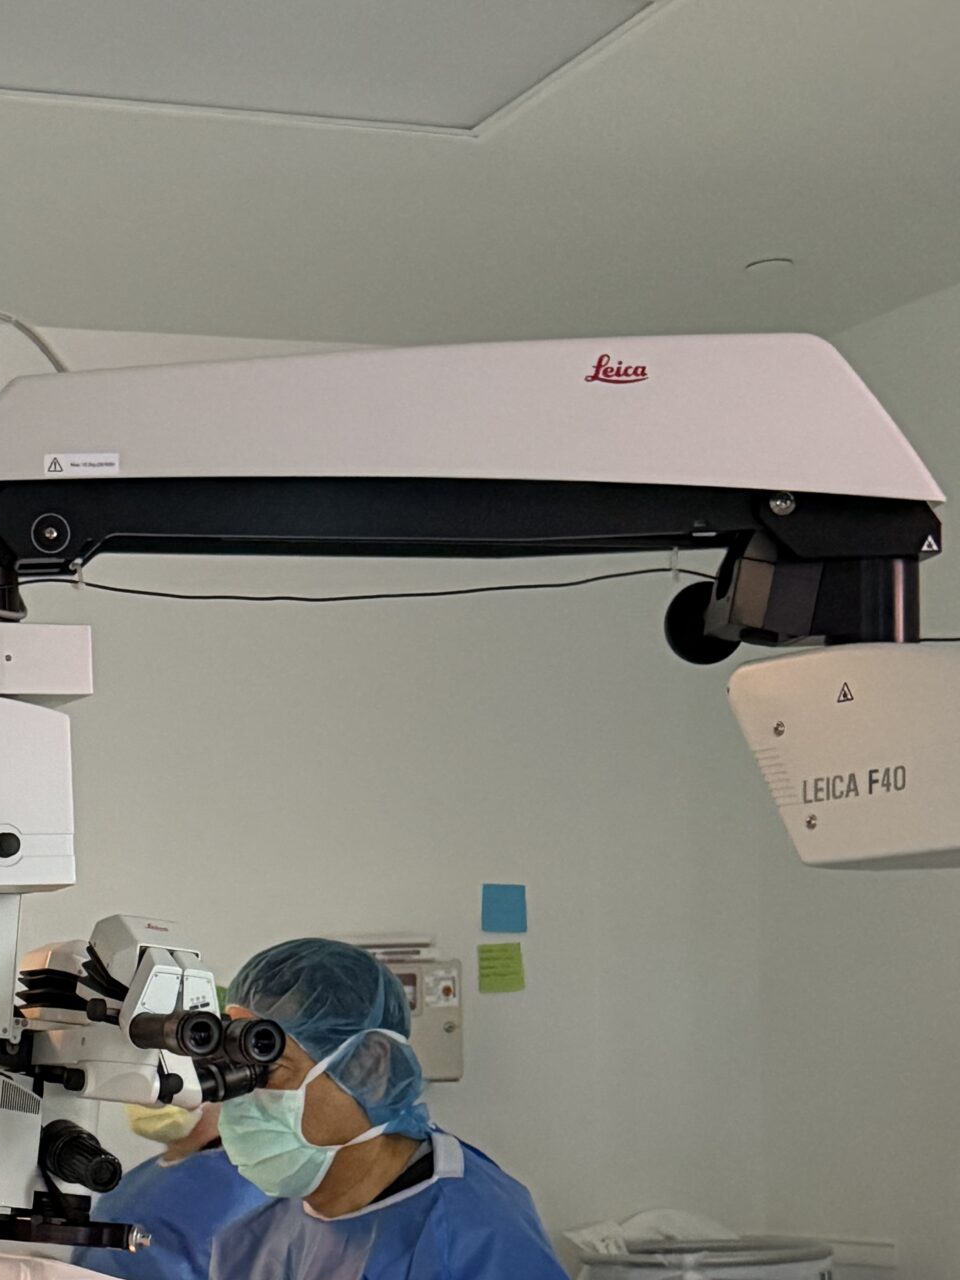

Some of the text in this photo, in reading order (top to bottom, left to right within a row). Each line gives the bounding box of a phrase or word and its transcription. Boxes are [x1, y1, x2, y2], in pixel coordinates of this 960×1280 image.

[585, 354, 648, 384] Leica
[803, 765, 906, 803] LEICA F40
